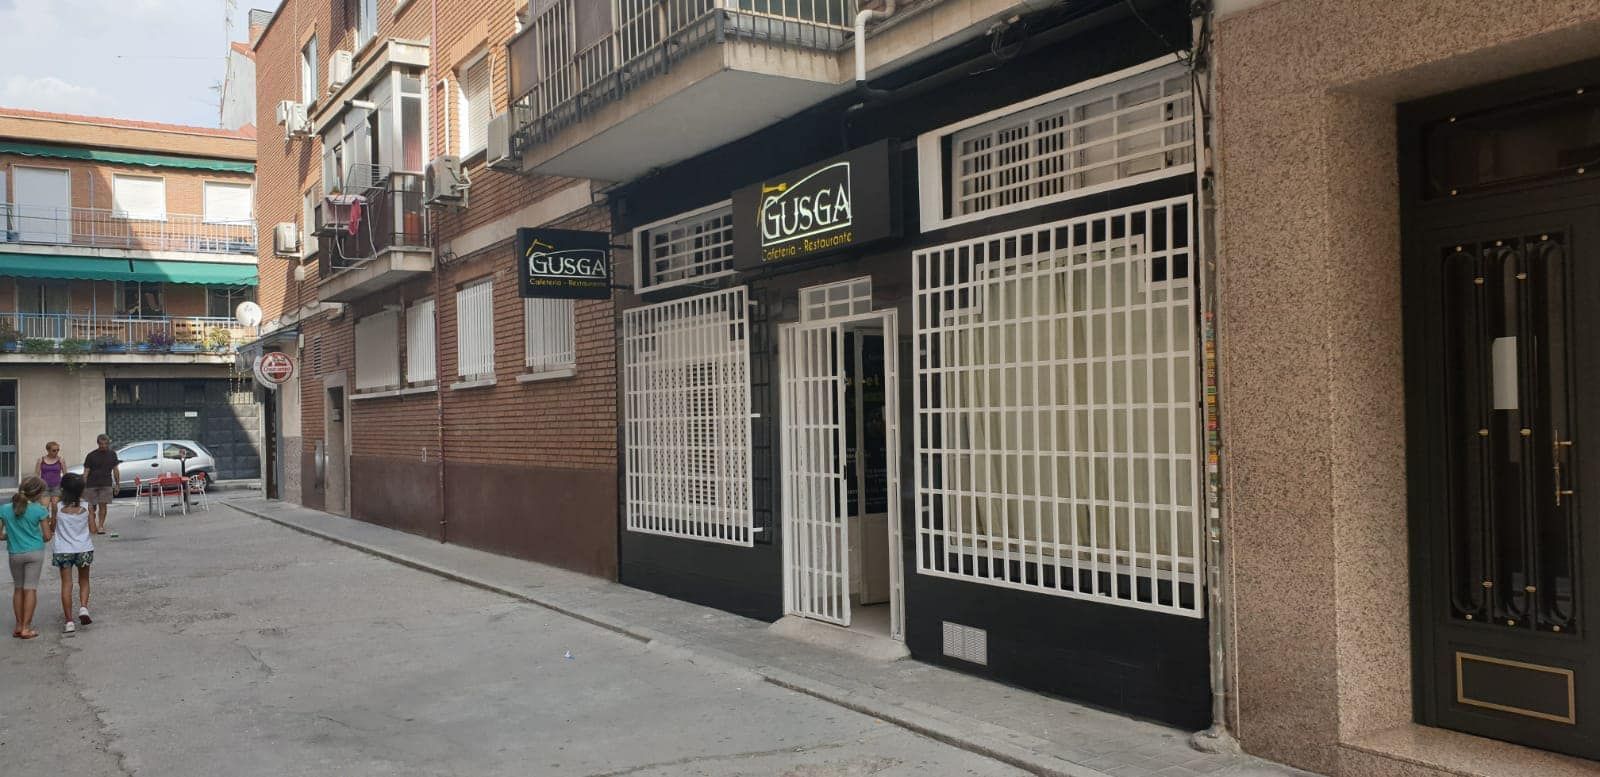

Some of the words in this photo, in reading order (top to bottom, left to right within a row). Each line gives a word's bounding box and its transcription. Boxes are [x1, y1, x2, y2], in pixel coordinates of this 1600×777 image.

[761, 183, 852, 239] GUSGA
[804, 231, 853, 252] Restaurante
[530, 252, 607, 276] GUSGA
